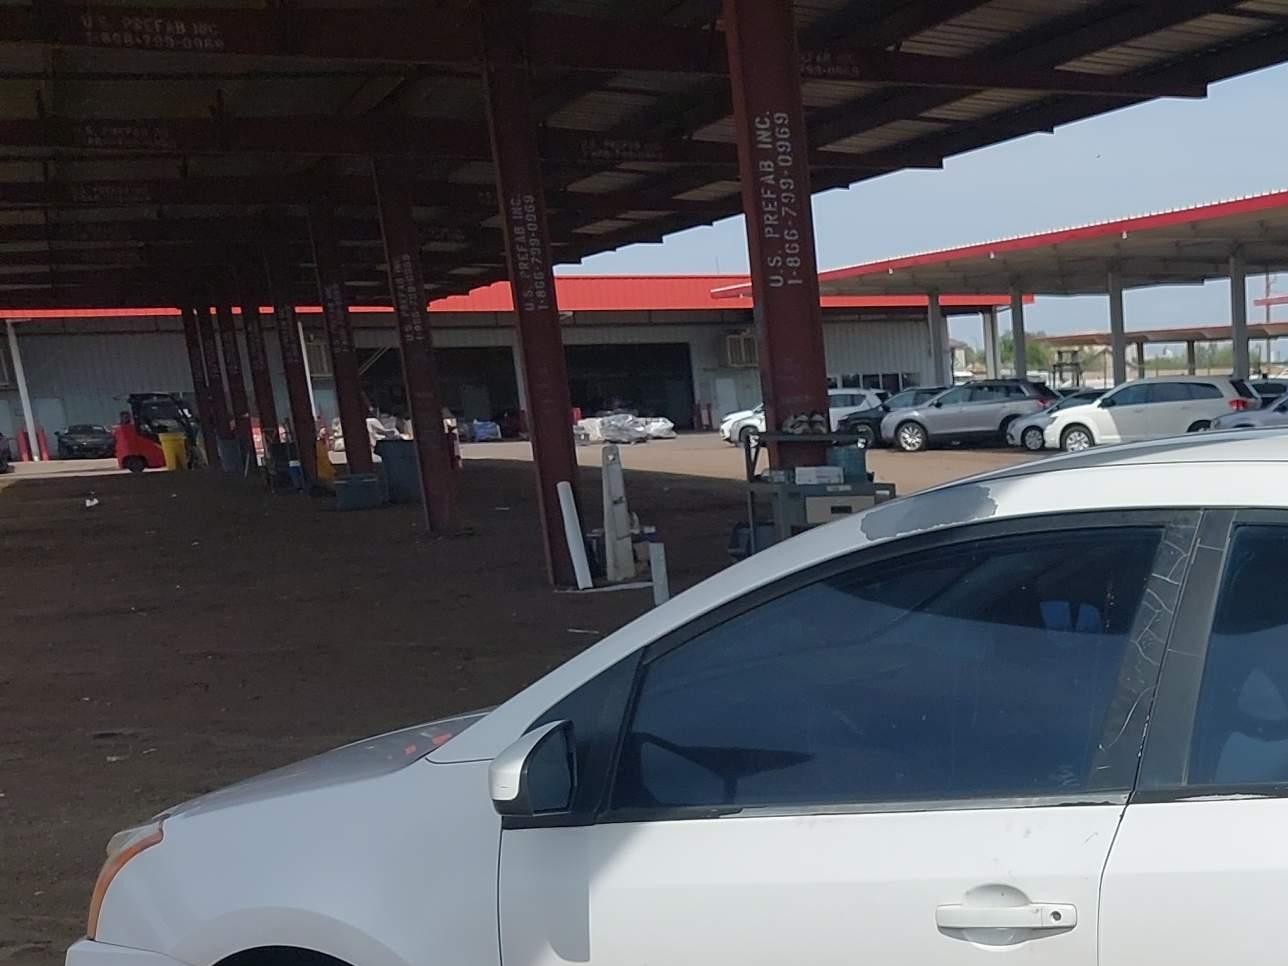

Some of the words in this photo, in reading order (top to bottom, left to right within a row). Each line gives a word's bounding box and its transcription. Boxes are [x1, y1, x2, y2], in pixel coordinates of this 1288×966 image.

[755, 111, 773, 149] INC.
[759, 160, 780, 238] PREFAB
[774, 112, 803, 285] 1-866-799-0969
[513, 225, 531, 279] PREFAB
[767, 250, 785, 288] U.S.
